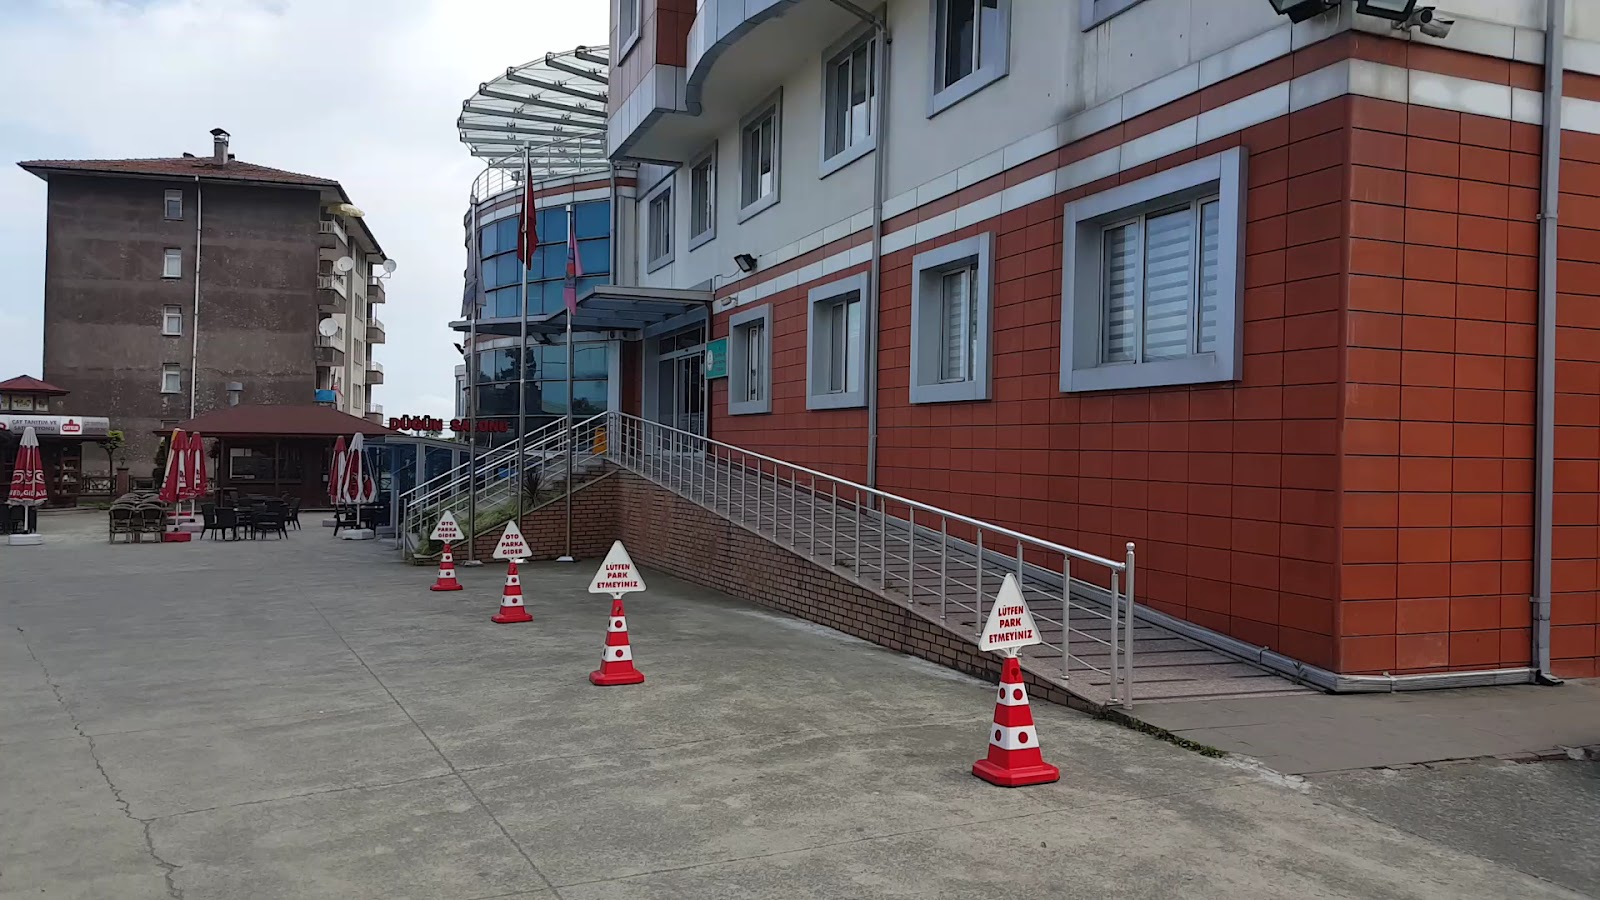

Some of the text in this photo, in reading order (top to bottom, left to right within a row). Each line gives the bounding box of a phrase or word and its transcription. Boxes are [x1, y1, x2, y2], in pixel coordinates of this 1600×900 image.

[389, 415, 443, 431] DÜĞÜN
[605, 562, 631, 571] LÜTFEN
[597, 580, 638, 589] ETMEYİNİZ
[998, 604, 1024, 617] LÜTFEN
[999, 617, 1022, 628] PARK
[989, 628, 1033, 644] ETMEYİNİZ
